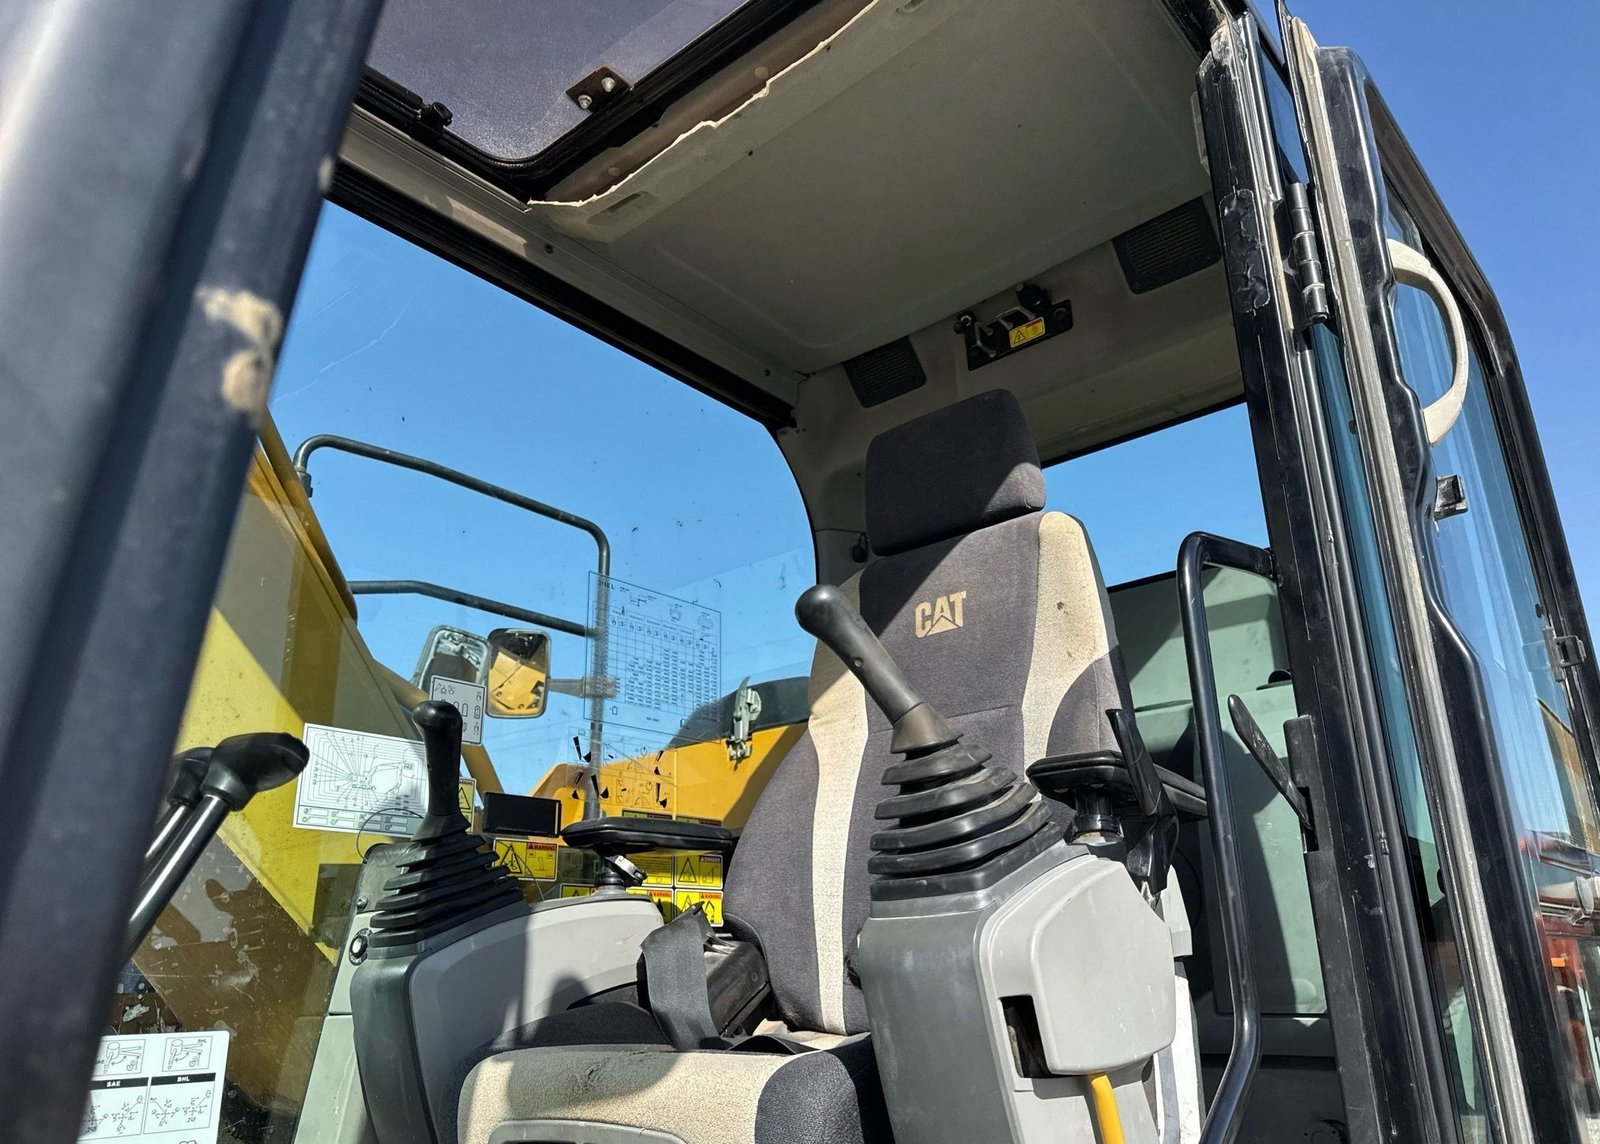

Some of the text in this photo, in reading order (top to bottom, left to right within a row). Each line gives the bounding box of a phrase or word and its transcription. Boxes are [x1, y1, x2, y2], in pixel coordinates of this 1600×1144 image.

[915, 590, 967, 639] CAT
[533, 844, 556, 852] WARNING
[177, 1075, 190, 1083] BHL
[106, 1080, 121, 1088] SAE
